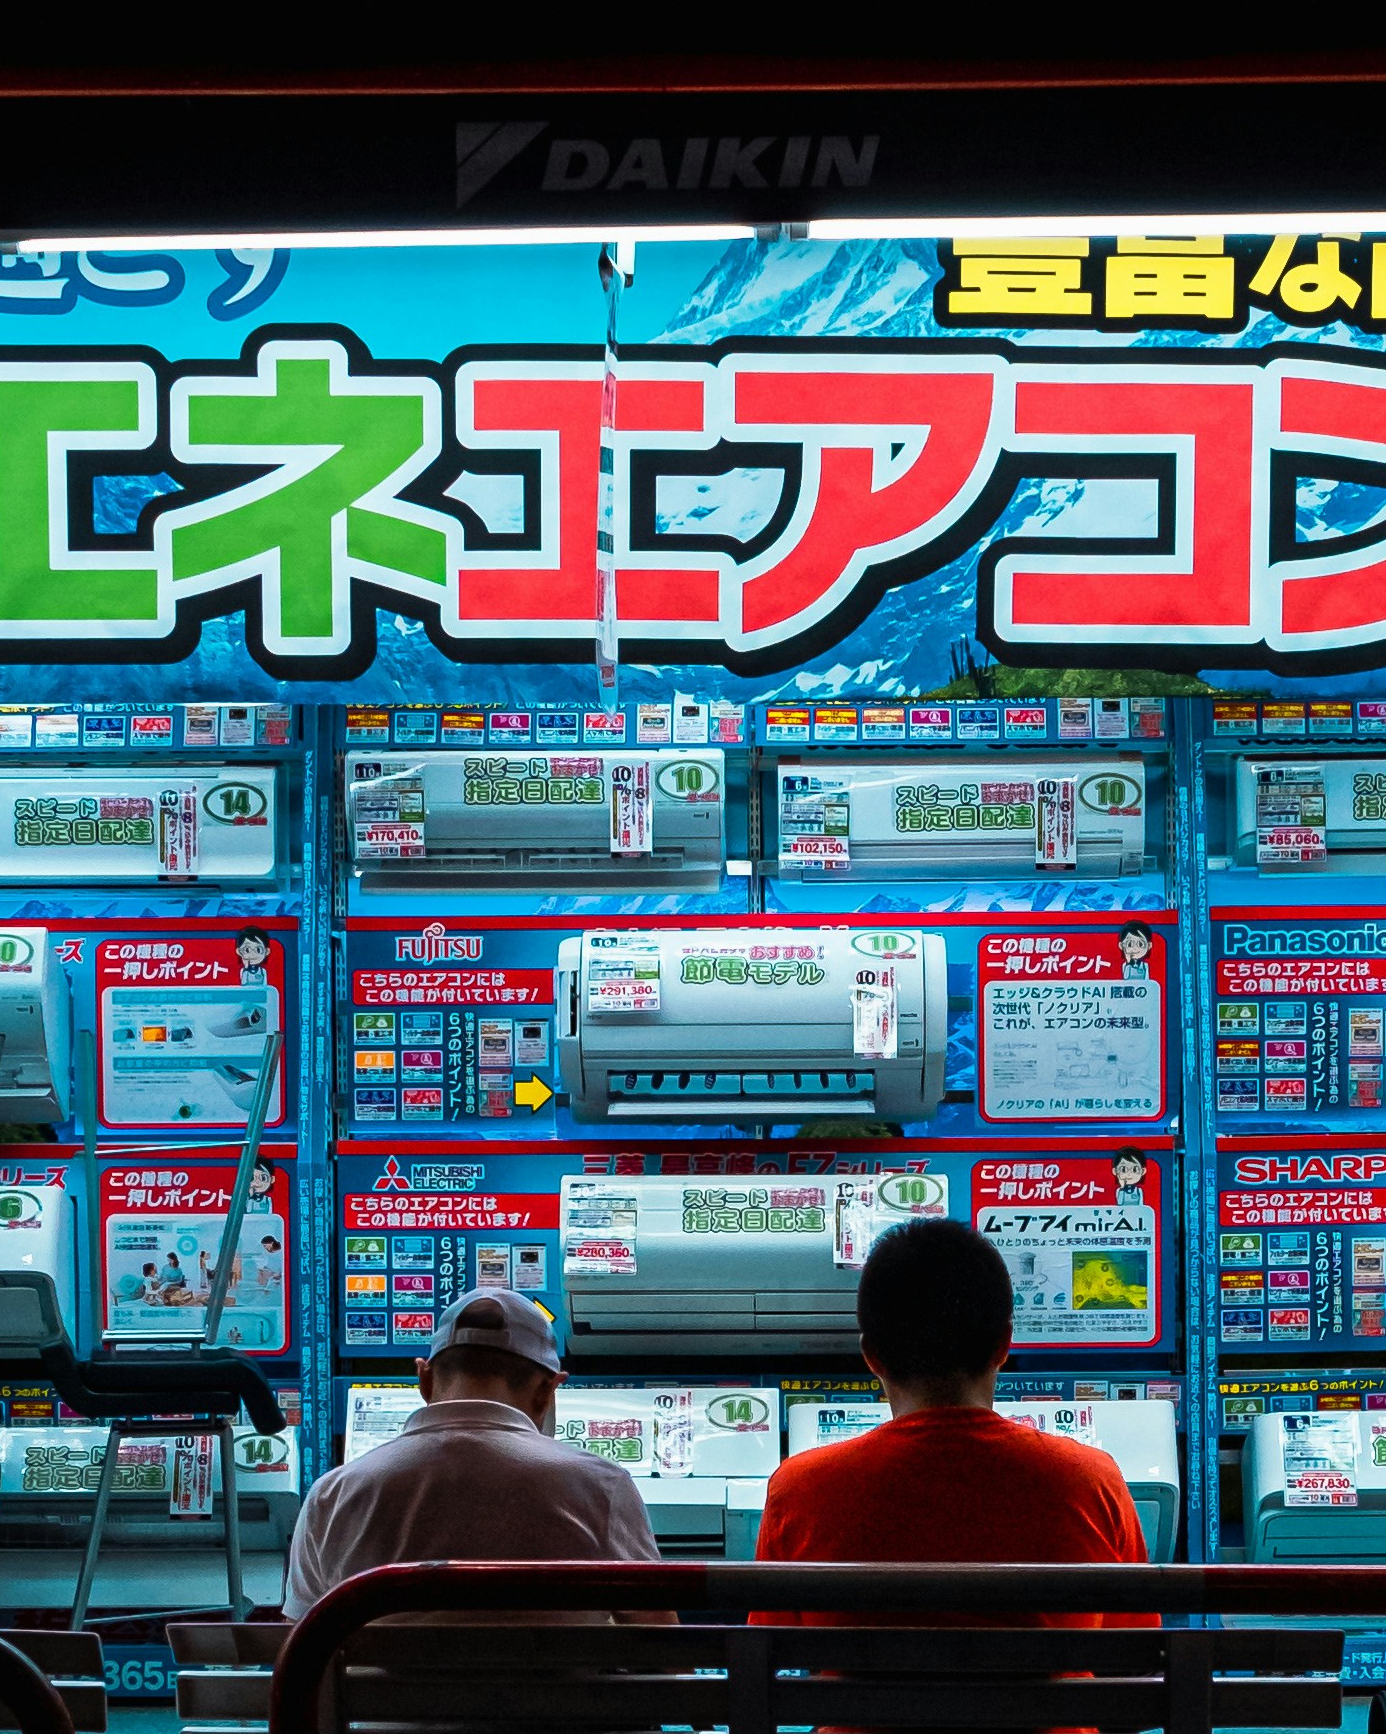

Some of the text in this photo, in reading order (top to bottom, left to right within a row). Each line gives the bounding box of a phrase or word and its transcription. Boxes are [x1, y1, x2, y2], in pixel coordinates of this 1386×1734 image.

[543, 135, 880, 193] DAIKIN
[671, 768, 702, 792] 10
[1095, 780, 1126, 805] 10
[219, 790, 250, 815] 14
[366, 829, 419, 843] ¥170,410
[792, 842, 843, 855] ¥102,150
[395, 922, 481, 964] FUJITSU
[868, 935, 897, 953] 10
[1223, 962, 1370, 976] こちらのエアコンには
[359, 973, 505, 987] こちらのエアコンには
[600, 985, 652, 995] ¥291,380
[412, 1165, 484, 1177] MITSUBISHI
[413, 1177, 475, 1189] ELECTRIC
[895, 1181, 926, 1204] 10
[1226, 1192, 1373, 1207] こちらのエアコンには
[350, 1197, 497, 1211] こちらのエアコンには
[983, 1214, 1073, 1233] ムーブアイ
[722, 1400, 752, 1423] 14
[242, 1439, 272, 1462] 14
[1298, 1477, 1350, 1489] ¥267,830
